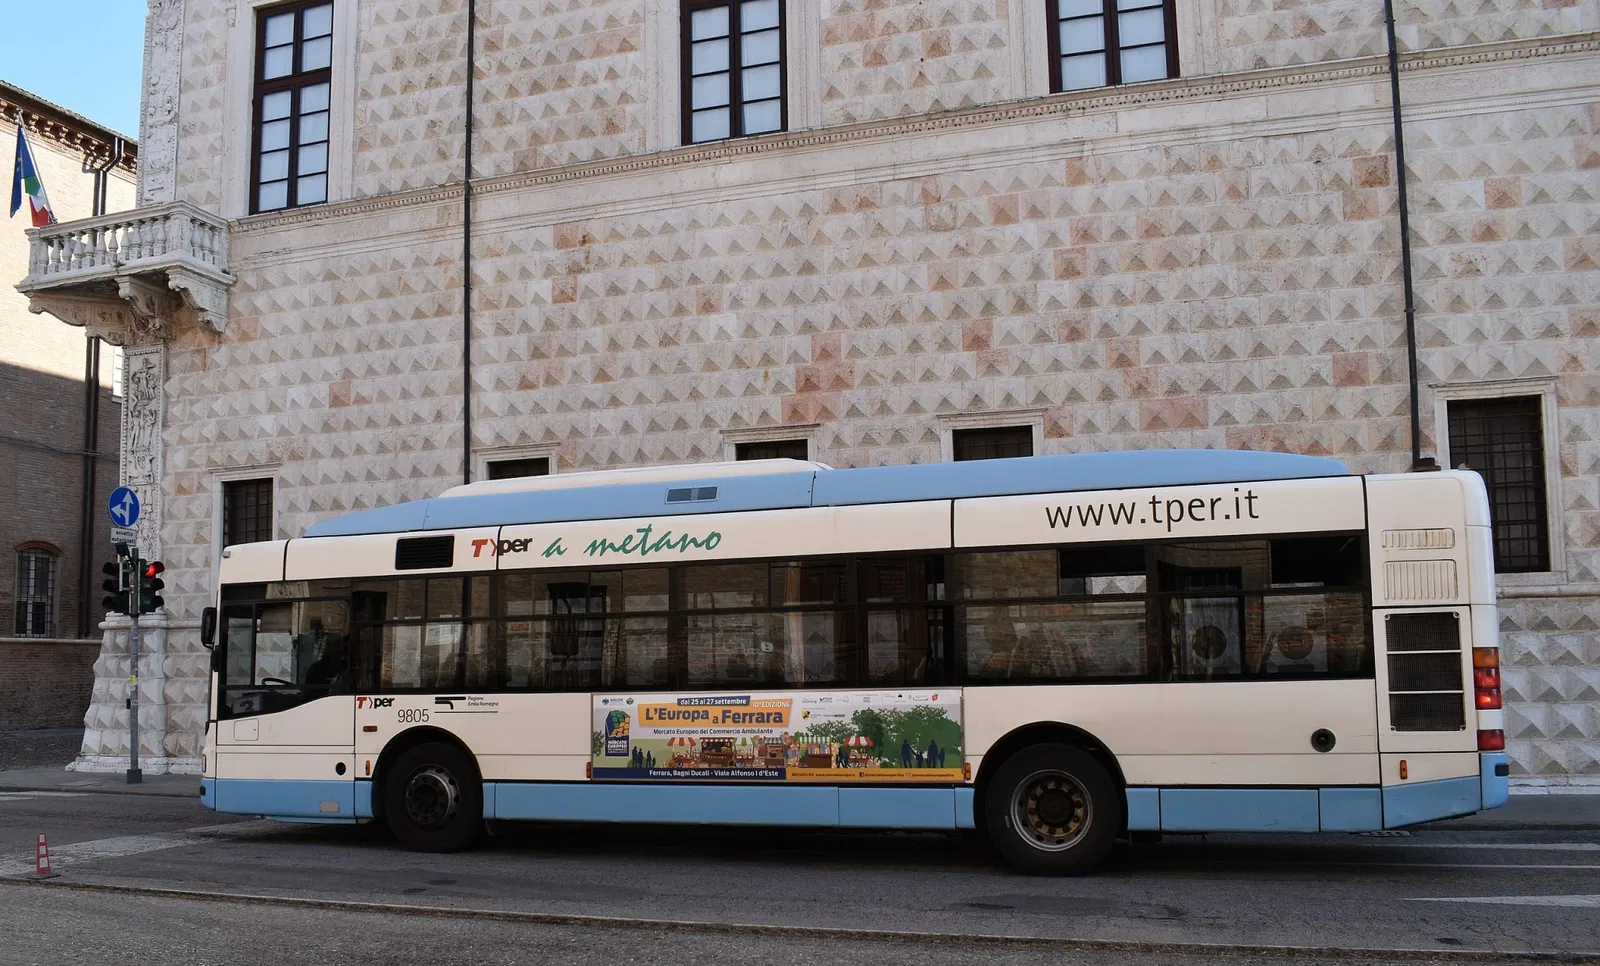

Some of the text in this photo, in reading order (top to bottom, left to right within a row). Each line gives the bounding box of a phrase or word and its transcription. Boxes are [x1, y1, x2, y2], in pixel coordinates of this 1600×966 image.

[1045, 487, 1260, 533] www.tper.it
[541, 537, 568, 558] a
[582, 523, 722, 557] metano
[680, 698, 690, 706] dal
[397, 708, 430, 723] 9805
[645, 707, 784, 724] L'Europa a Ferrara
[676, 728, 699, 736] Europeo
[741, 727, 774, 735] Ambulante
[649, 769, 673, 777] Ferrara,
[673, 769, 690, 777] Bagni
